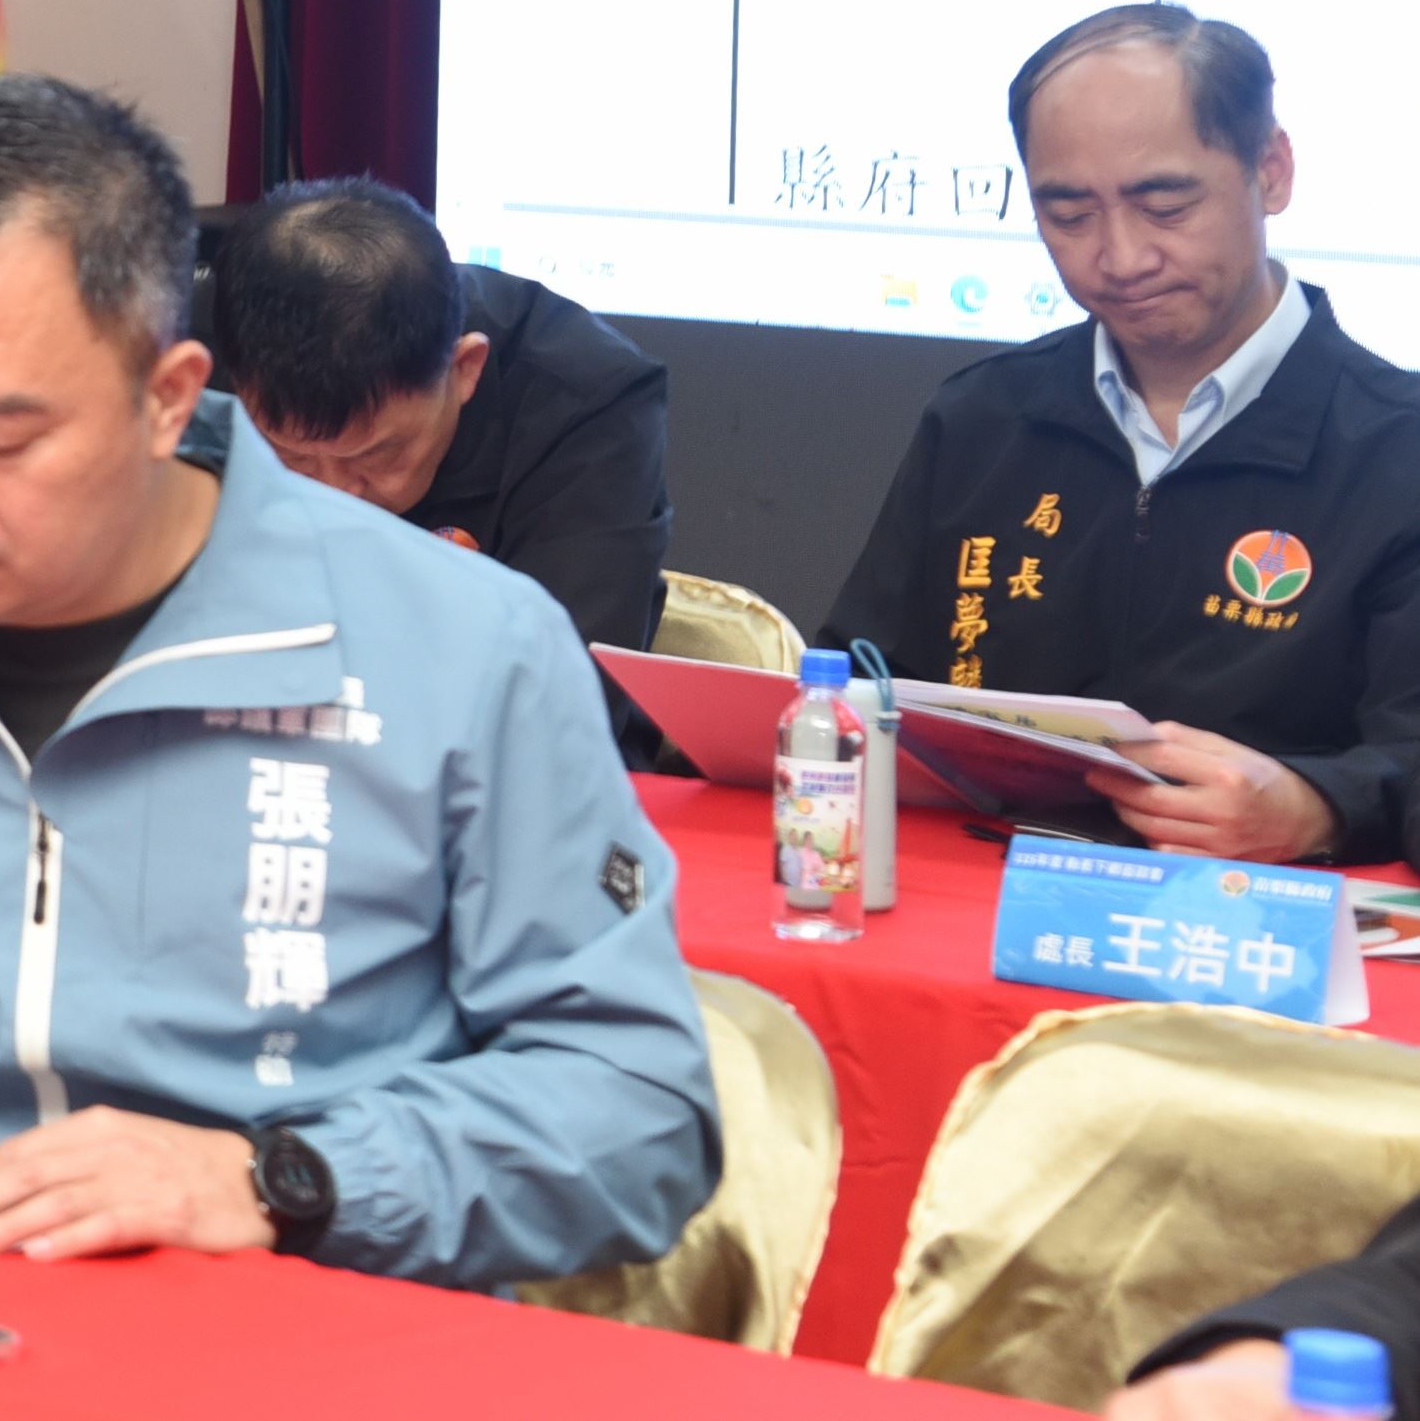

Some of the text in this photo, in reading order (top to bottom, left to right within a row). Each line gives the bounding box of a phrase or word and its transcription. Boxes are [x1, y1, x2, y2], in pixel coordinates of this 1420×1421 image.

[773, 143, 1015, 221] 縣府回
[1006, 492, 1063, 601] 局長
[242, 756, 334, 1013] 張朋輝
[1101, 911, 1297, 994] 王浩中
